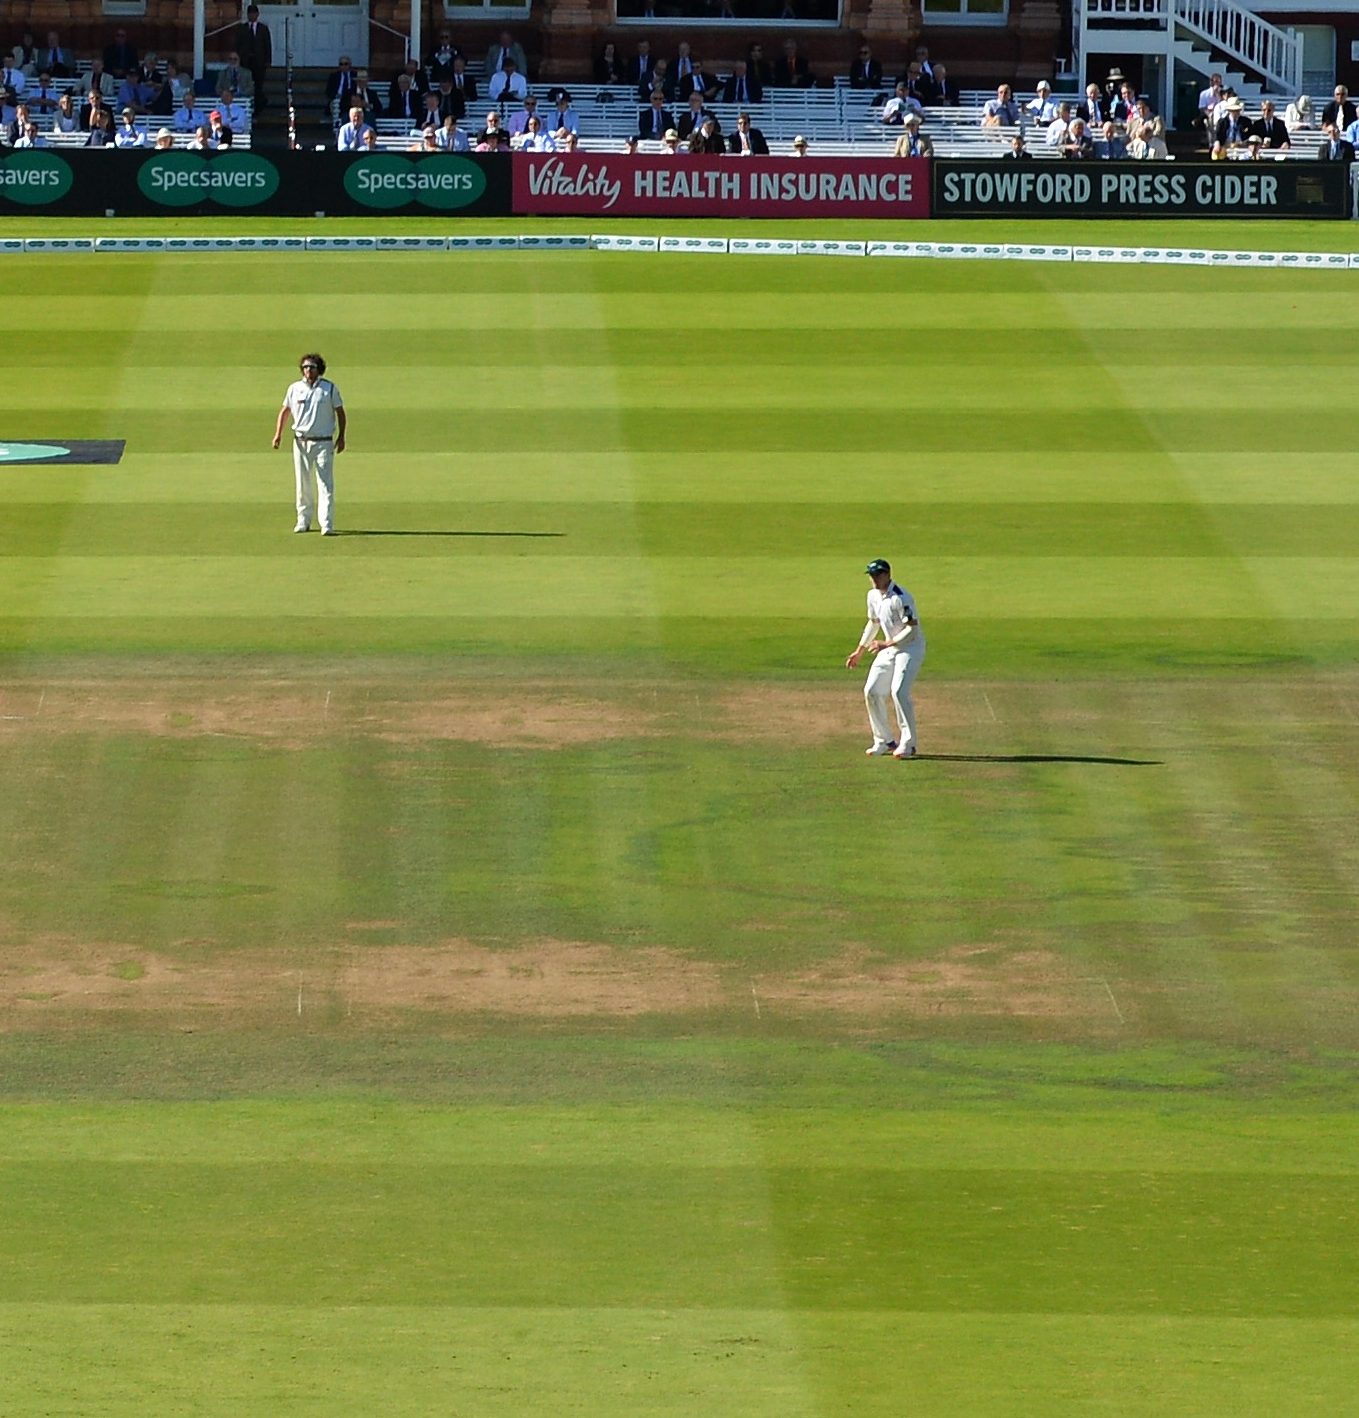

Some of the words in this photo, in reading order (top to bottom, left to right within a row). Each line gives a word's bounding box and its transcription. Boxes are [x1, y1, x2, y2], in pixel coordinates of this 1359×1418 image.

[151, 166, 266, 191] Specsavers
[357, 168, 473, 193] Specsavers
[528, 156, 622, 209] Vitality
[634, 170, 740, 200] HEALTH
[750, 172, 913, 202] INSURANCE
[943, 172, 1091, 203] STOWFORD
[1101, 174, 1186, 204] PRESS
[1195, 174, 1278, 205] CIDER
